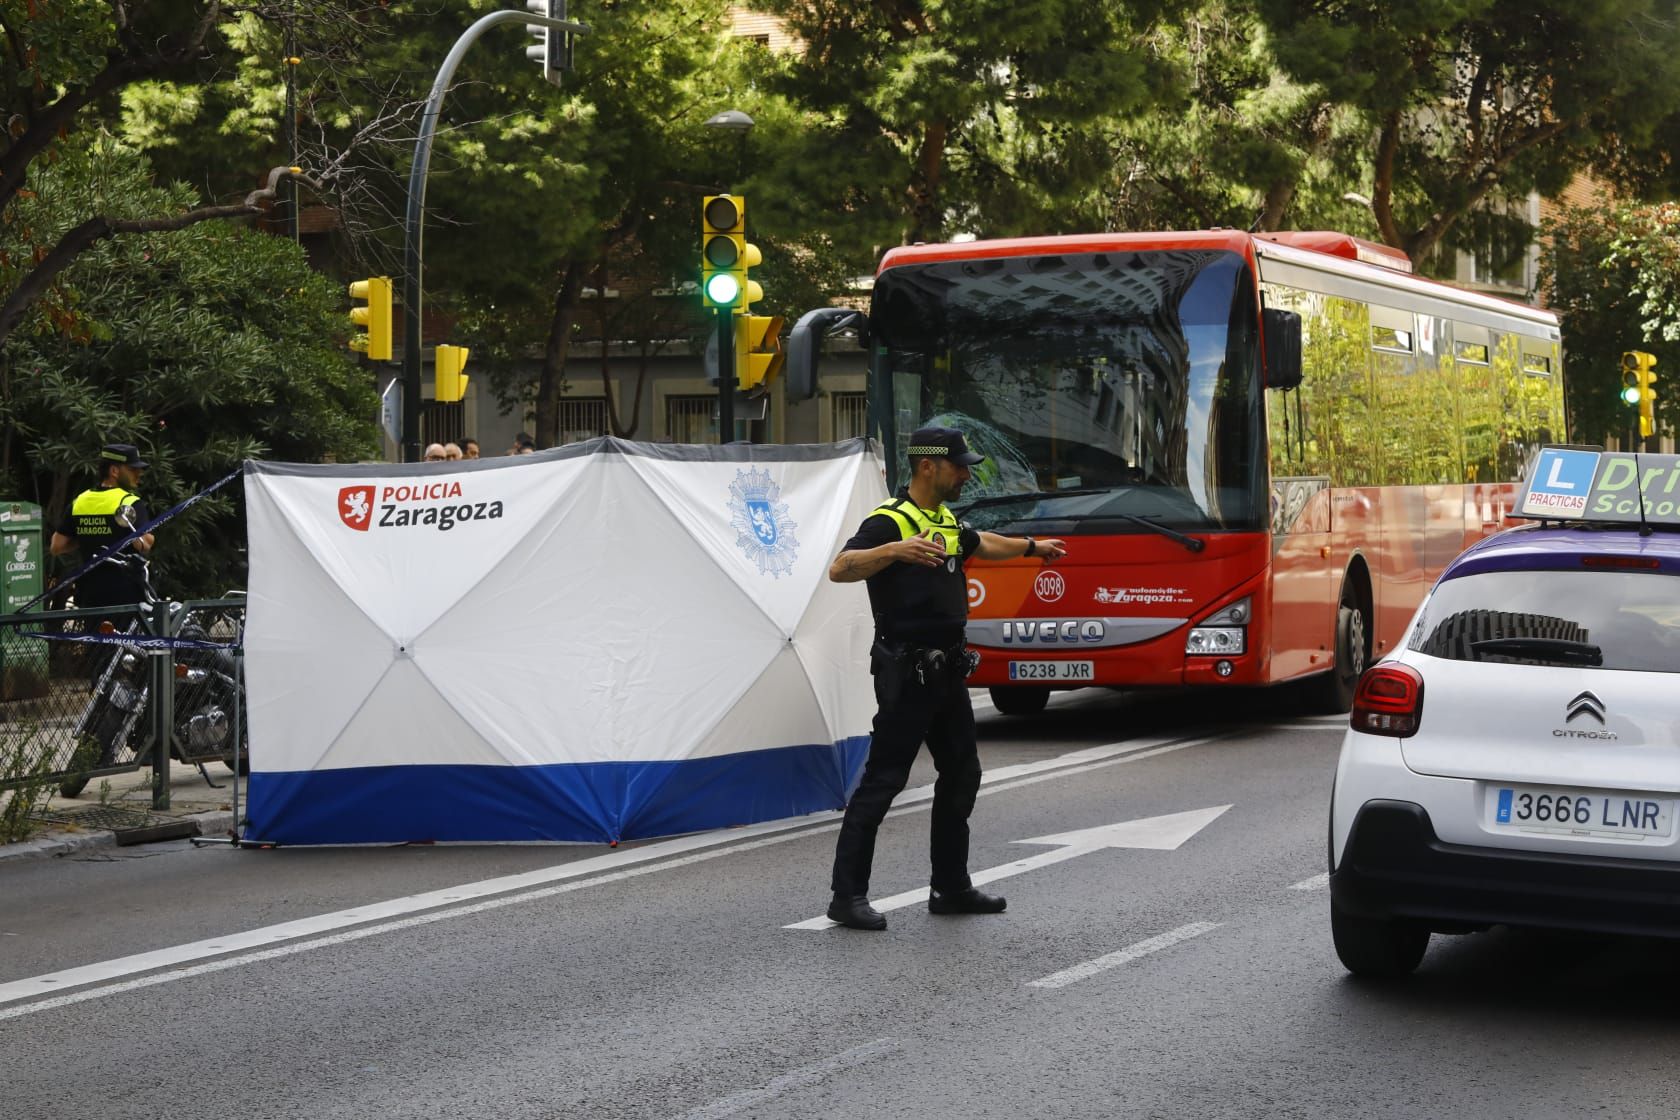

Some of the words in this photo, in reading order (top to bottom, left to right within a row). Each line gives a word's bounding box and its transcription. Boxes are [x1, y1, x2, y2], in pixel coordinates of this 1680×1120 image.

[1546, 458, 1575, 489] L
[382, 482, 462, 502] POLICIA
[1529, 493, 1585, 509] PRACTICAS
[1592, 494, 1680, 516] Scho
[79, 517, 107, 526] POLICIA
[379, 500, 504, 531] Zaragoza
[76, 526, 112, 535] ZARAGOZA
[1038, 577, 1061, 596] 3098
[1003, 621, 1105, 643] IVECO
[1019, 664, 1056, 678] 6238
[1063, 664, 1090, 678] JXR
[1516, 793, 1591, 824] 3666
[1602, 799, 1660, 830] LNR
